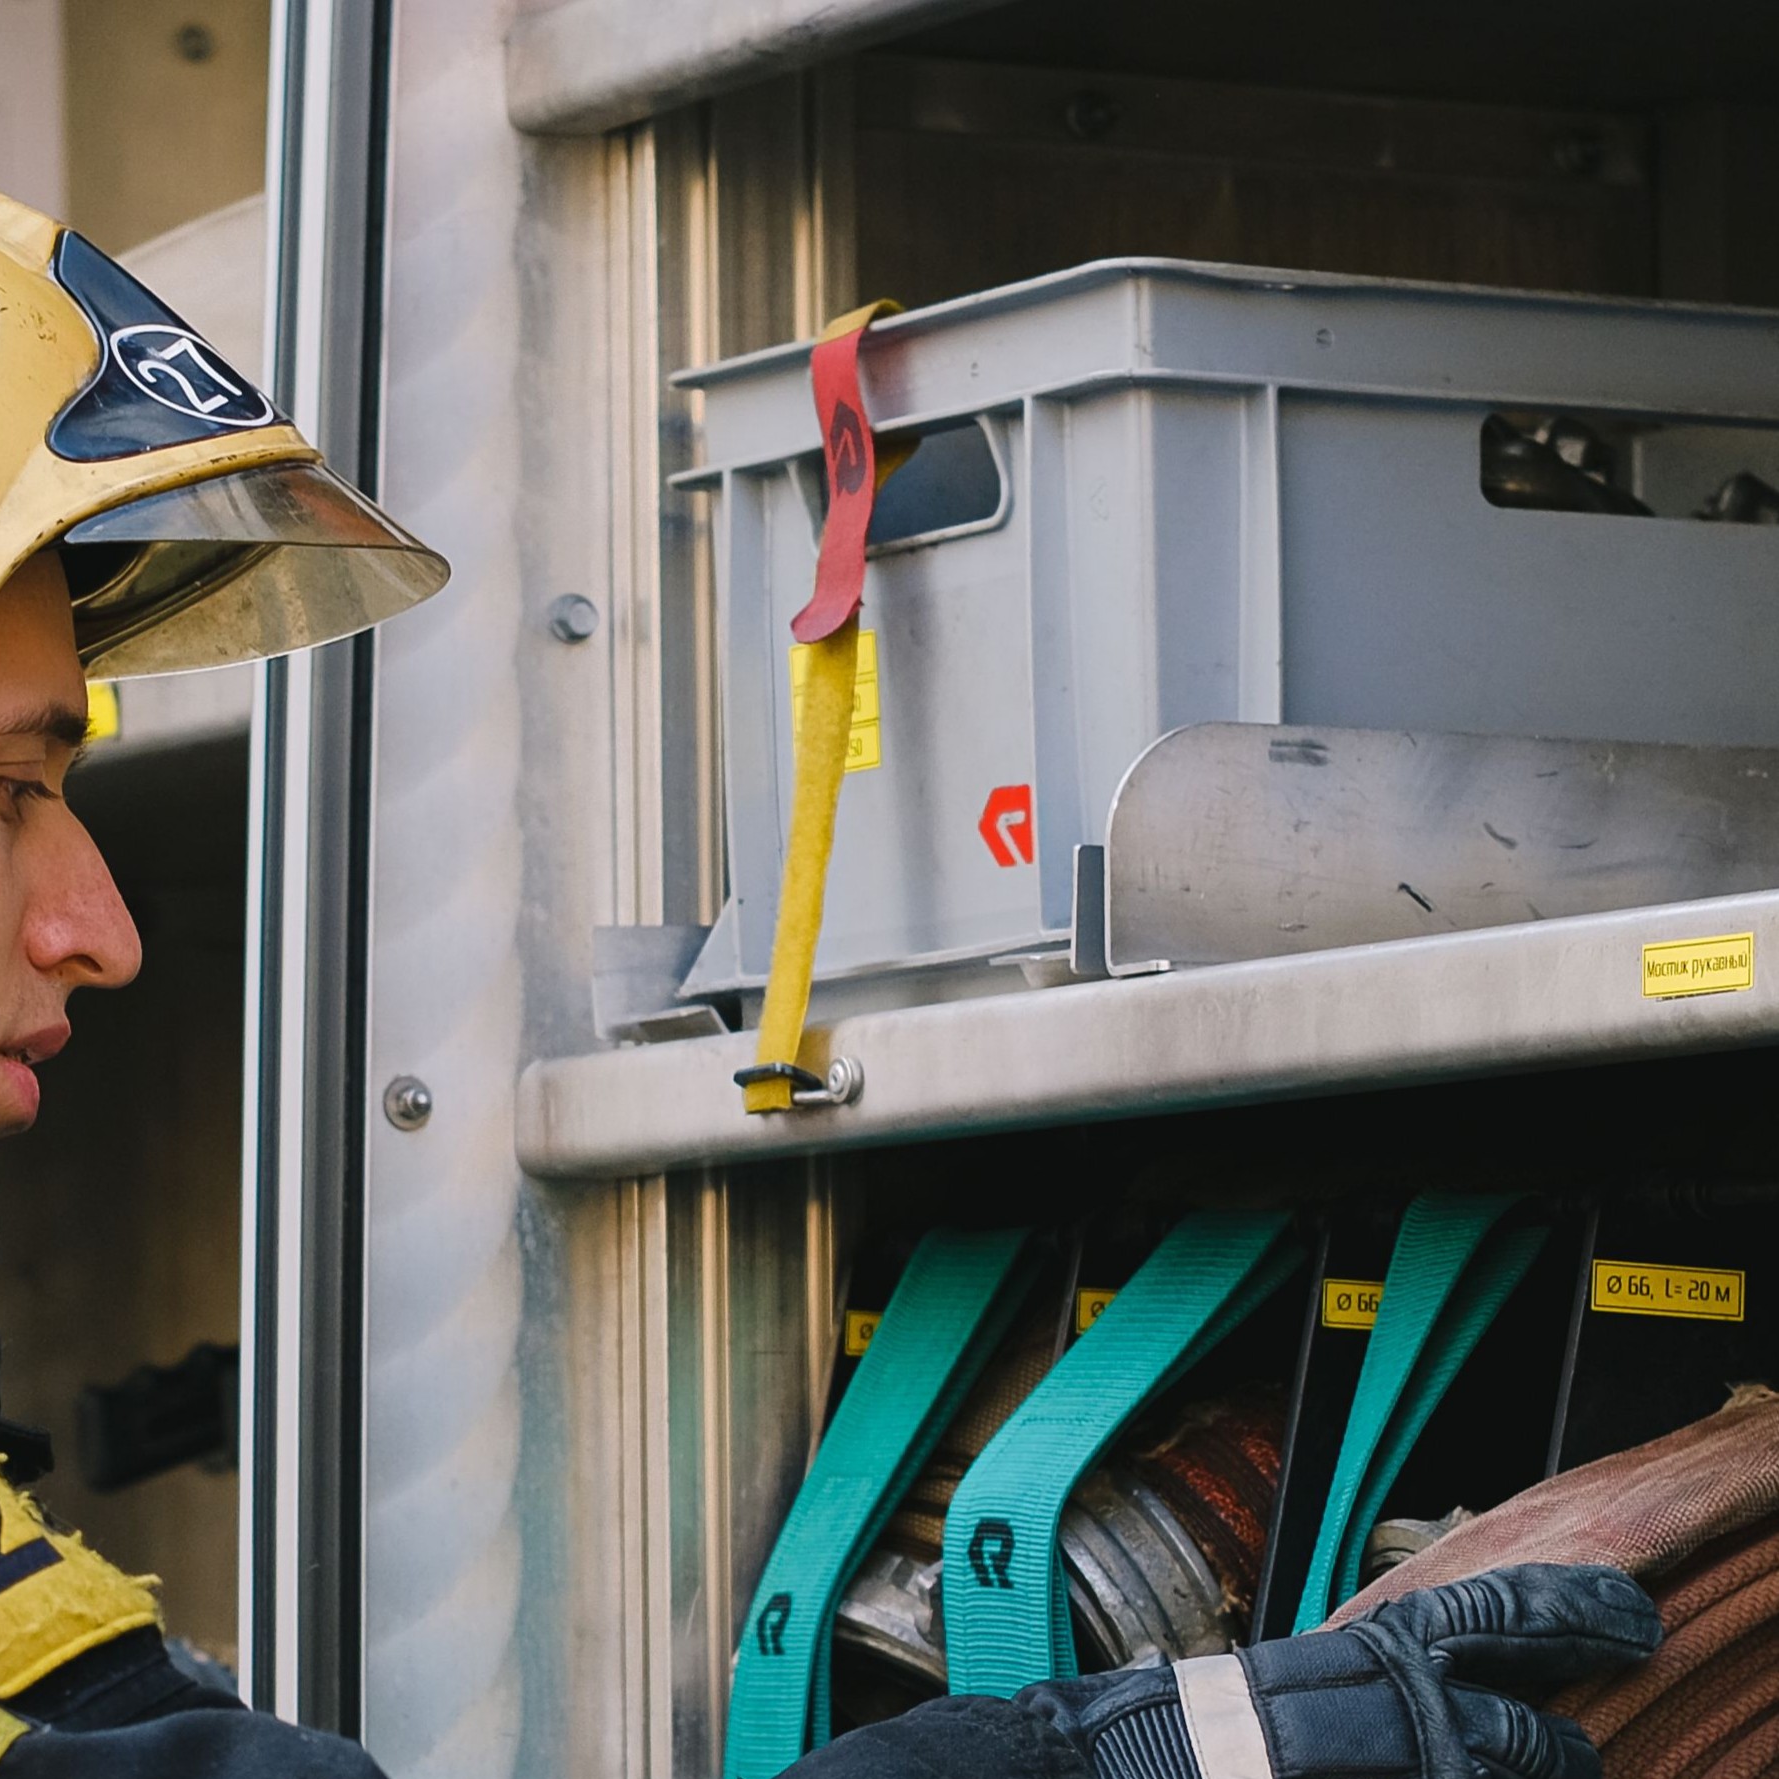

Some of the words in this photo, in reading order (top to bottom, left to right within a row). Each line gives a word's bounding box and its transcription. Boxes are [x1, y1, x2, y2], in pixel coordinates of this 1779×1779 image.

[136, 337, 243, 414] 27
[1647, 960, 1689, 978] Мостик
[1687, 1279, 1710, 1302] 20
[1357, 1293, 1380, 1313] 66
